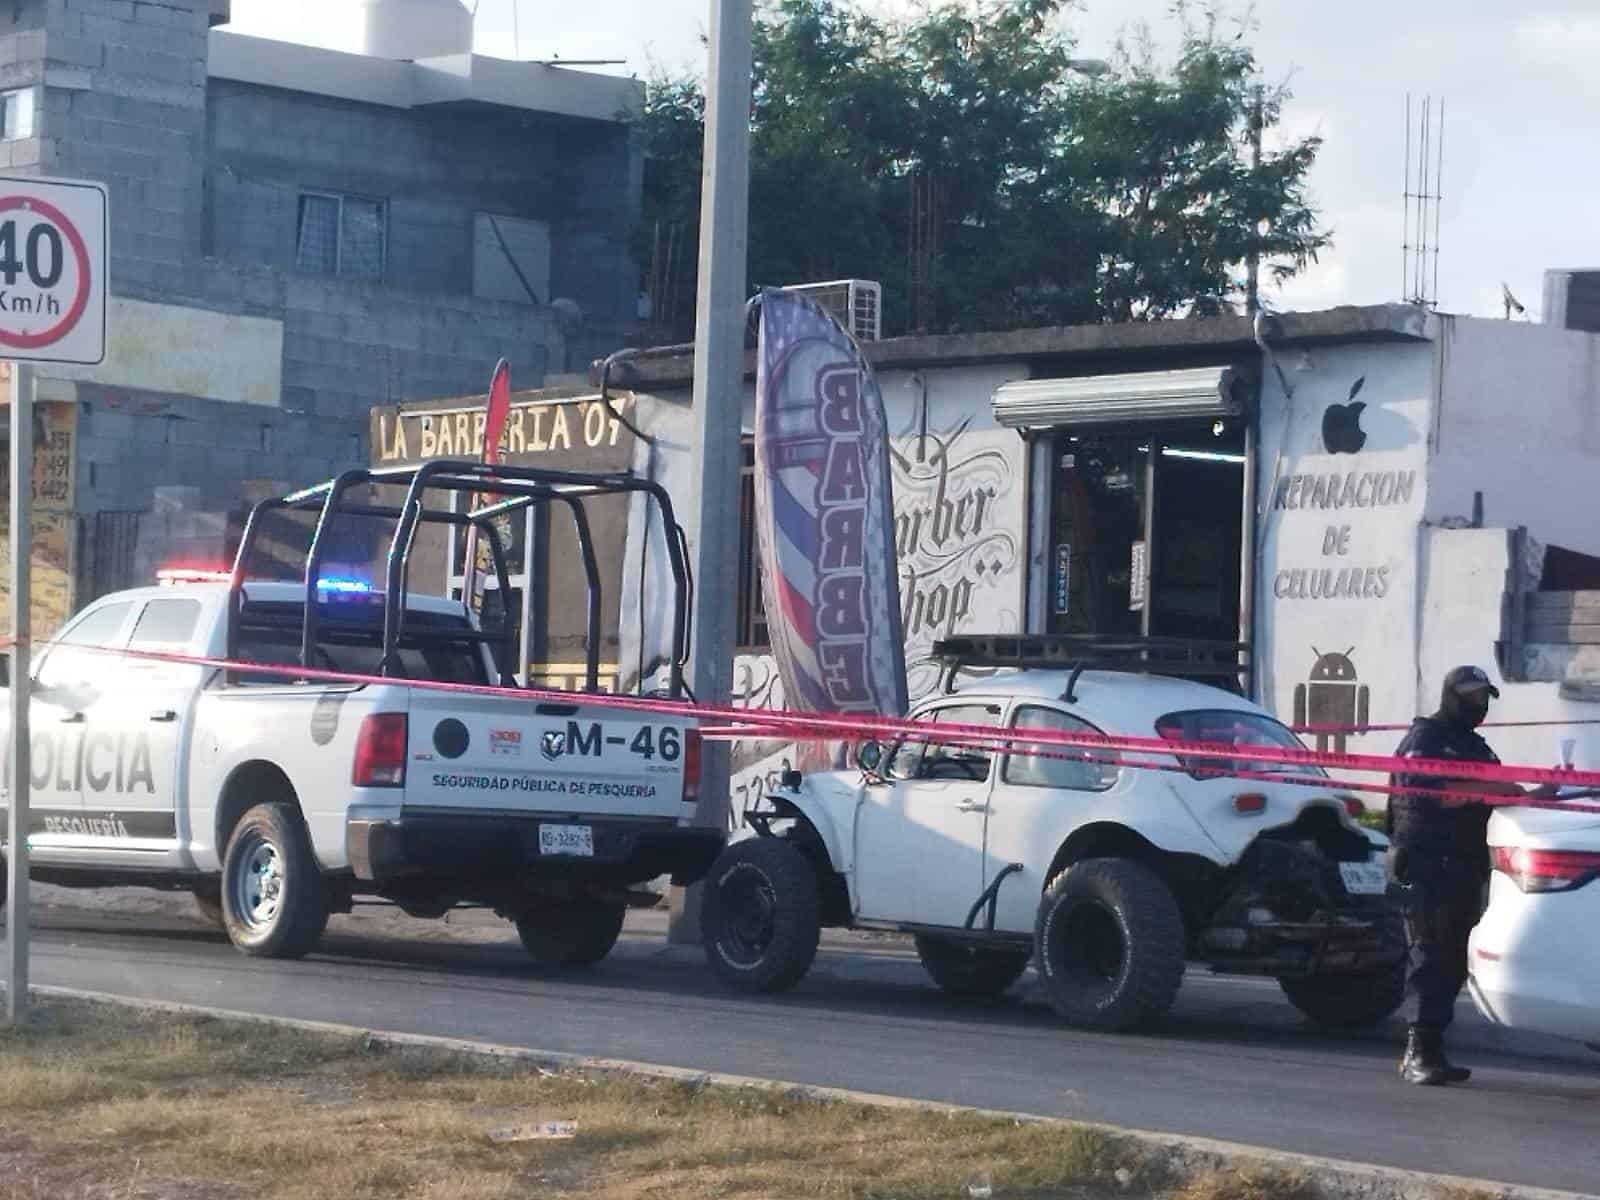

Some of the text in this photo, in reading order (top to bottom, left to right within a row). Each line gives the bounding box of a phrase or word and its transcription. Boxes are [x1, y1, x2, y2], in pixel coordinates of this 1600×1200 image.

[0, 220, 63, 289] 40
[379, 414, 408, 460] LA
[420, 403, 570, 458] BARBRIA
[1275, 470, 1416, 510] REPARACION
[1322, 525, 1351, 556] DE
[1273, 566, 1390, 600] CELULARES
[566, 721, 681, 762] M-46
[3, 731, 156, 794] OLICIA
[432, 774, 510, 790] SEGURIDAD
[569, 781, 586, 795] DE
